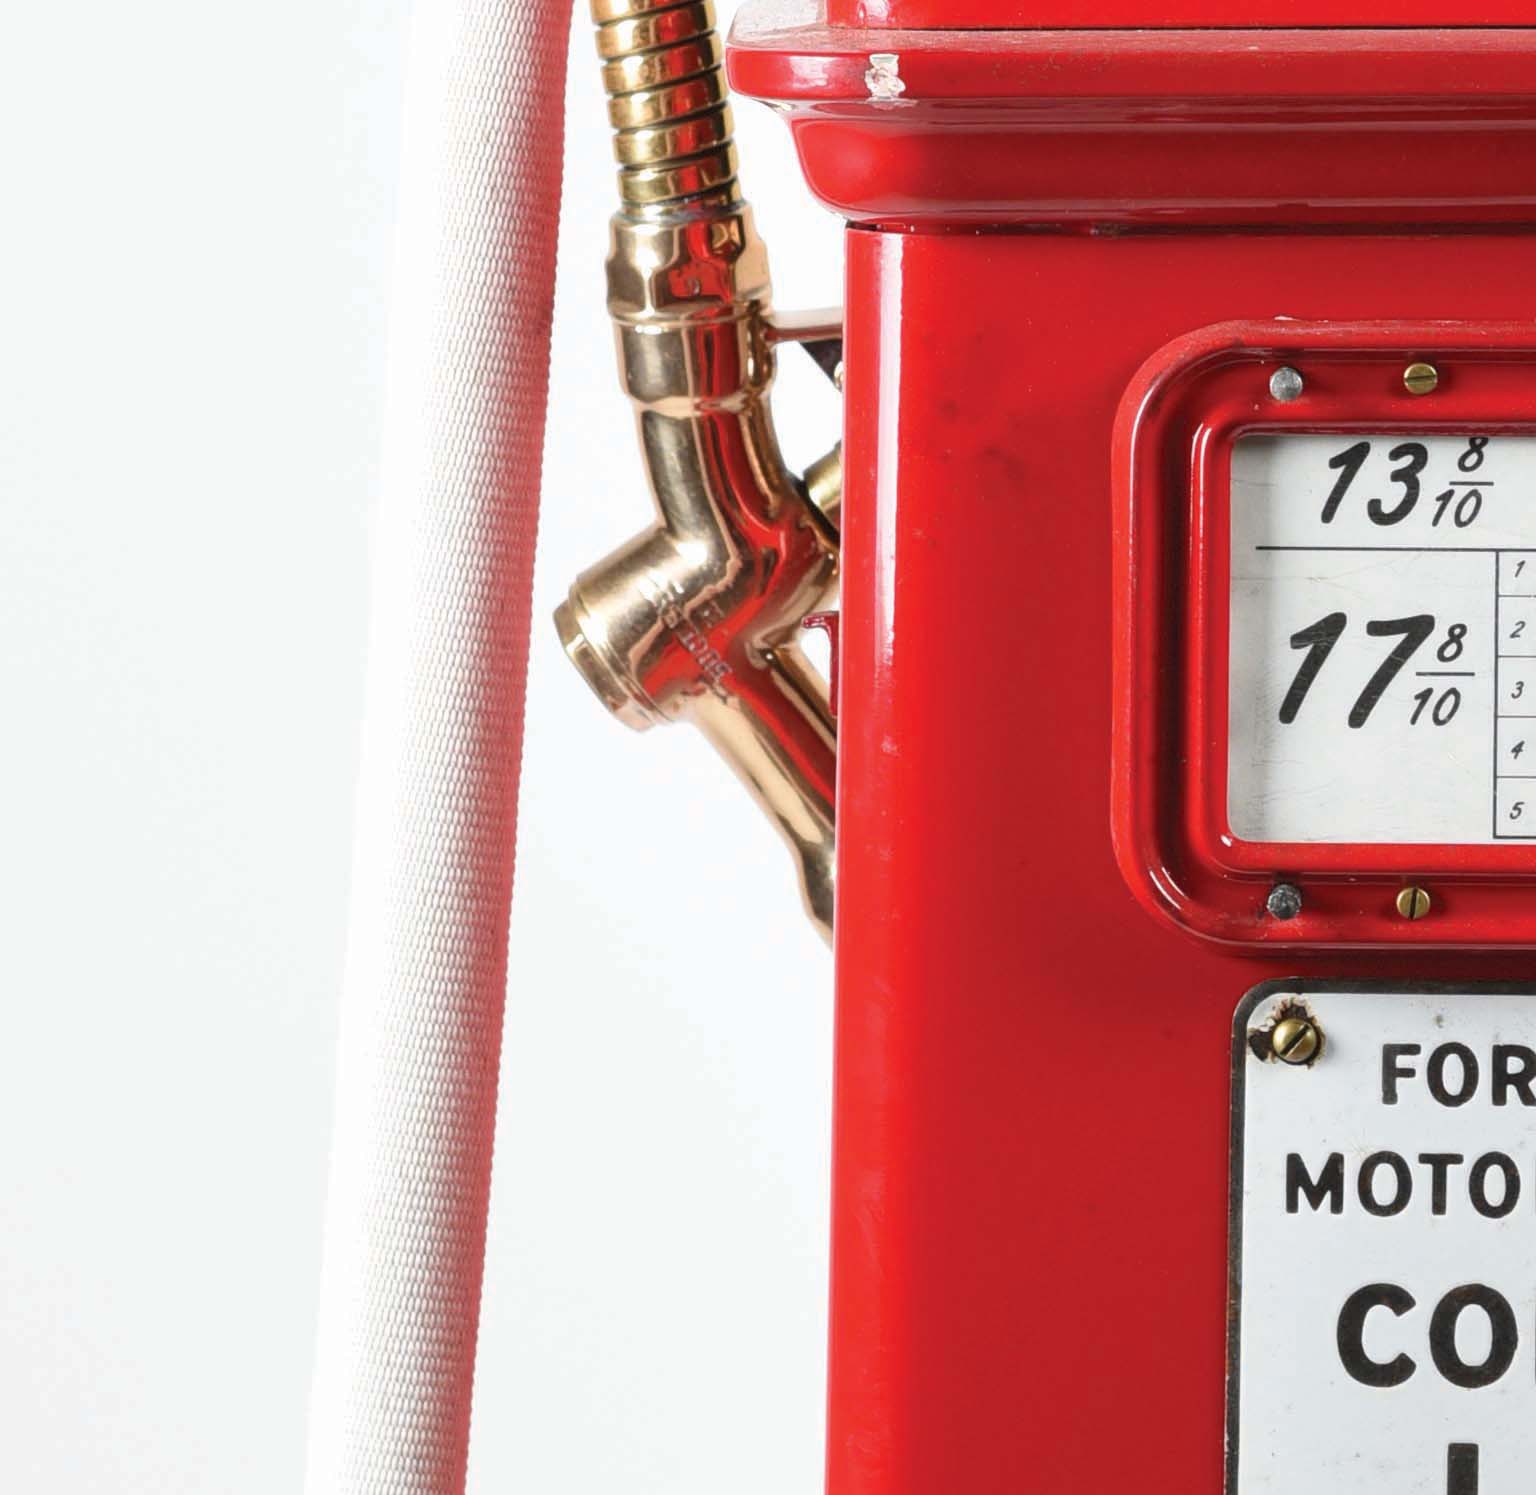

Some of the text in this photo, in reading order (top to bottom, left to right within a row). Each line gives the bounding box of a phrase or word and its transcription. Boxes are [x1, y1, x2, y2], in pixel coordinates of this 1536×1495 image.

[1317, 438, 1432, 526] 13
[1432, 488, 1481, 530] 10
[1515, 560, 1525, 577] 1
[1510, 621, 1526, 638] 2
[1278, 612, 1467, 728] 17 8 10
[1511, 681, 1524, 699] 3
[1511, 741, 1525, 759] 4
[1510, 802, 1524, 819] 5
